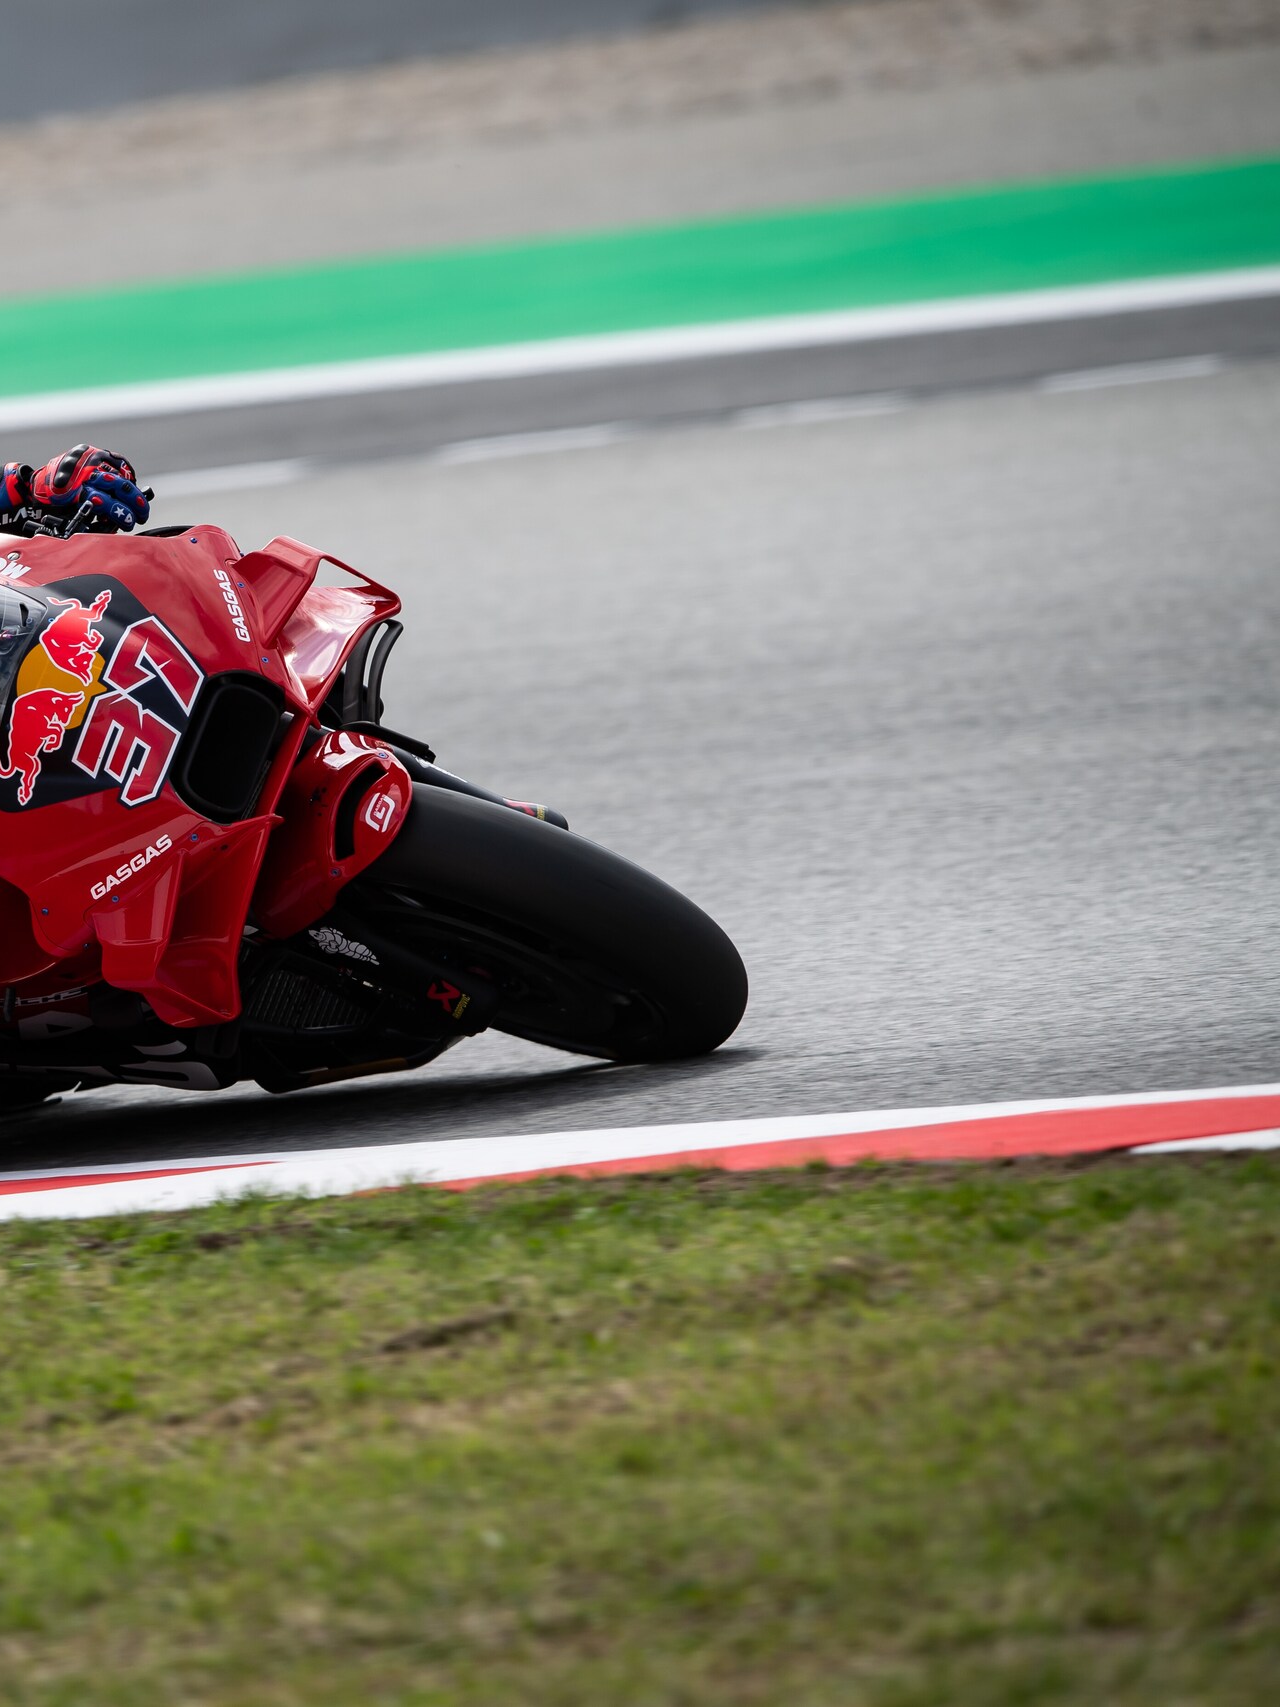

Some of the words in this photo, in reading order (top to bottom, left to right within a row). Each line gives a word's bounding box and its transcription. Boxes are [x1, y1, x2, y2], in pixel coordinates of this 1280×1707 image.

[213, 569, 251, 642] GASGAS
[72, 615, 206, 807] 37
[90, 833, 173, 900] GASGAS
